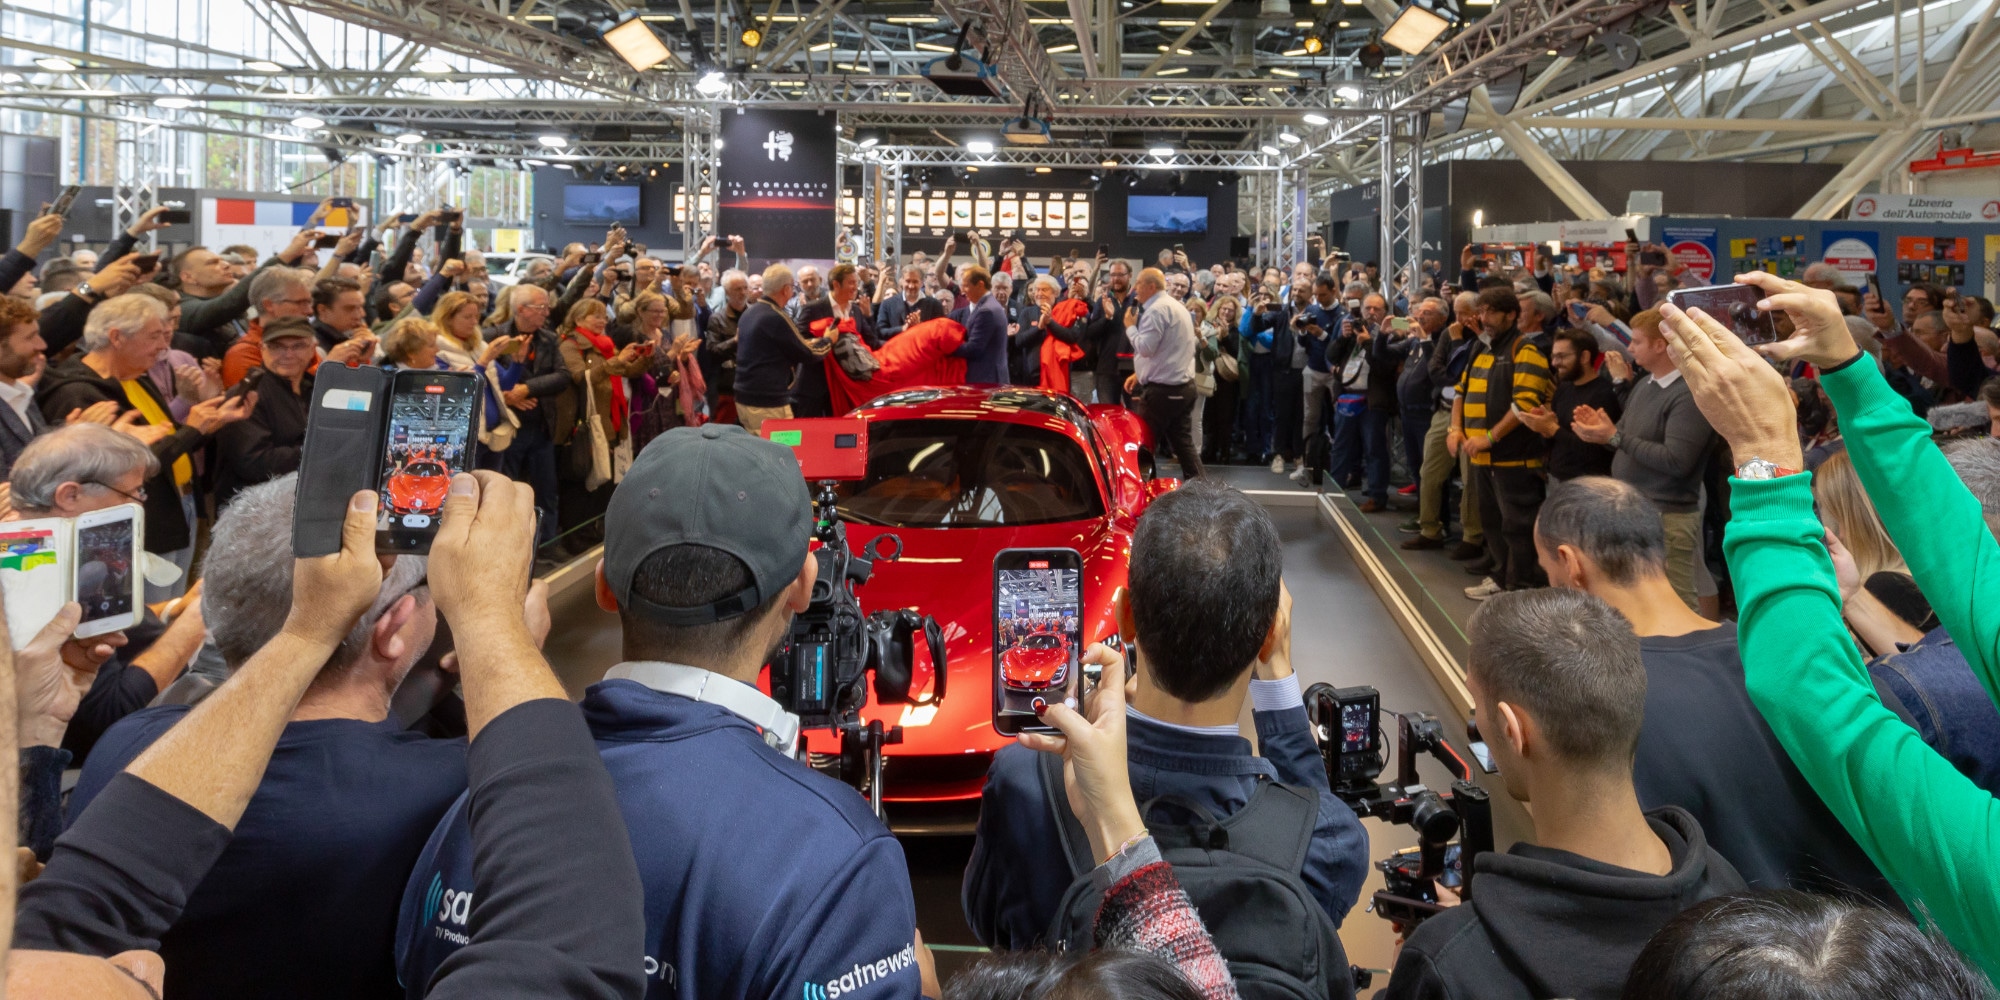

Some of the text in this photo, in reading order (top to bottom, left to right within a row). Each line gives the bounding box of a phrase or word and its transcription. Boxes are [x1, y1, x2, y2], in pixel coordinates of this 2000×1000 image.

[728, 181, 828, 189] IL CORAGGIO
[732, 189, 824, 198] DI SOGNARE
[1908, 198, 1953, 208] Libreria
[1882, 209, 1972, 220] dell'Automobile
[435, 926, 444, 939] TV
